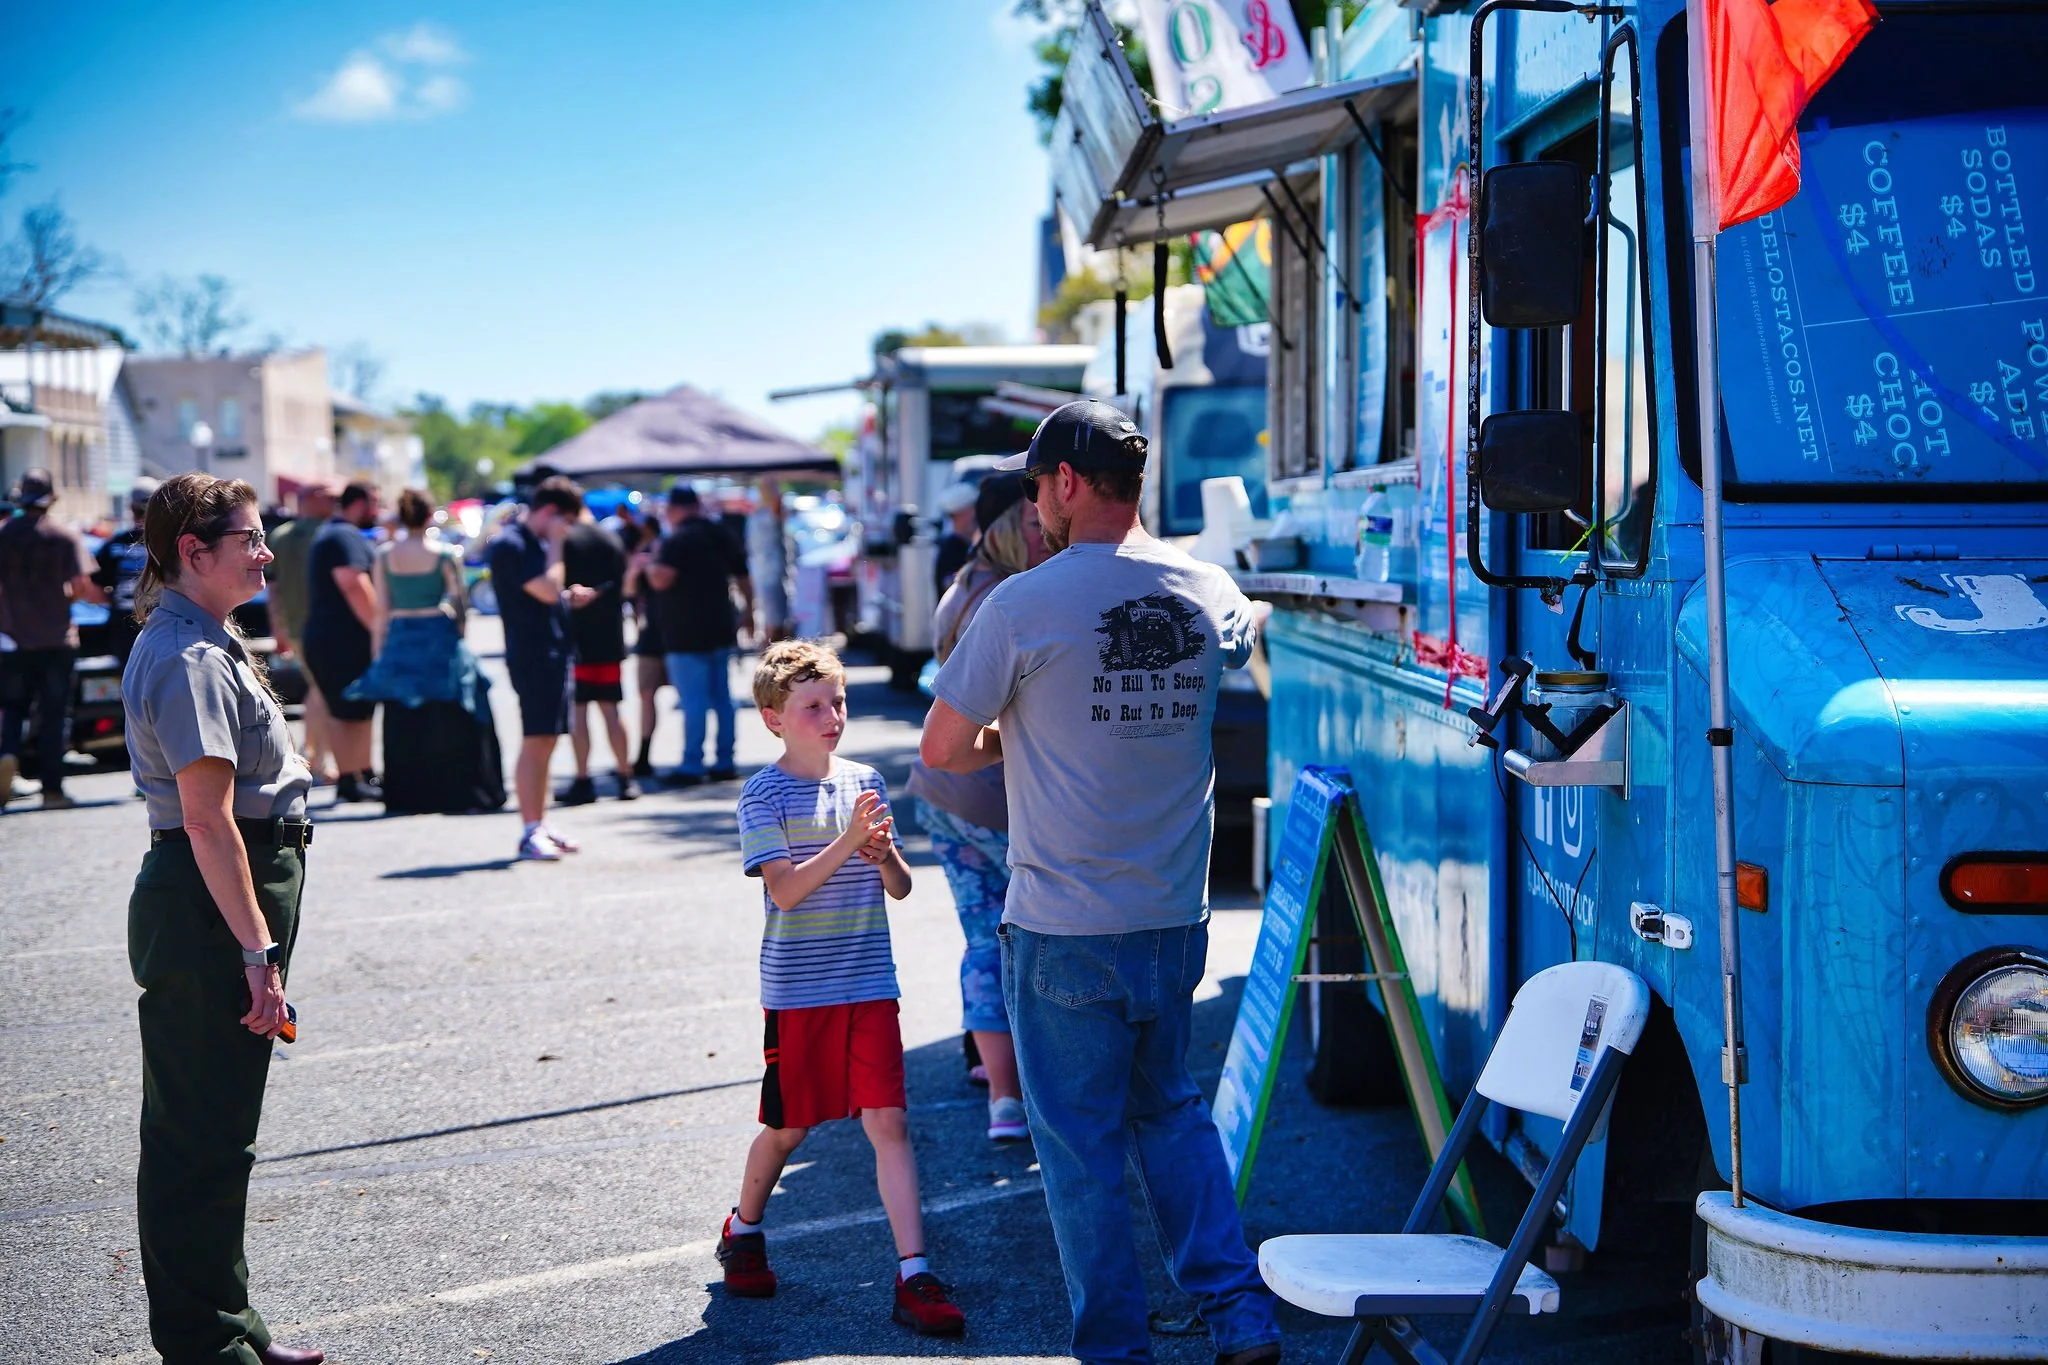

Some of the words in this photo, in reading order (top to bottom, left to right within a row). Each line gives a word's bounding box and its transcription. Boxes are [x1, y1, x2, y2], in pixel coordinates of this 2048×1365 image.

[1838, 203, 1870, 256] $4
[1863, 140, 1915, 306] COFFEE
[1939, 195, 1967, 239] $4
[1961, 149, 2003, 268] SODAS
[1986, 125, 2036, 293] BOTTLED
[1997, 360, 2036, 440] ADE
[2021, 319, 2048, 446] POW
[1846, 394, 1878, 446] $4
[1091, 705, 1111, 721] No
[1120, 704, 1142, 721] Rut
[1150, 703, 1164, 720] To
[1092, 676, 1112, 693] No
[1121, 675, 1143, 692] Hill
[1150, 673, 1165, 691] To
